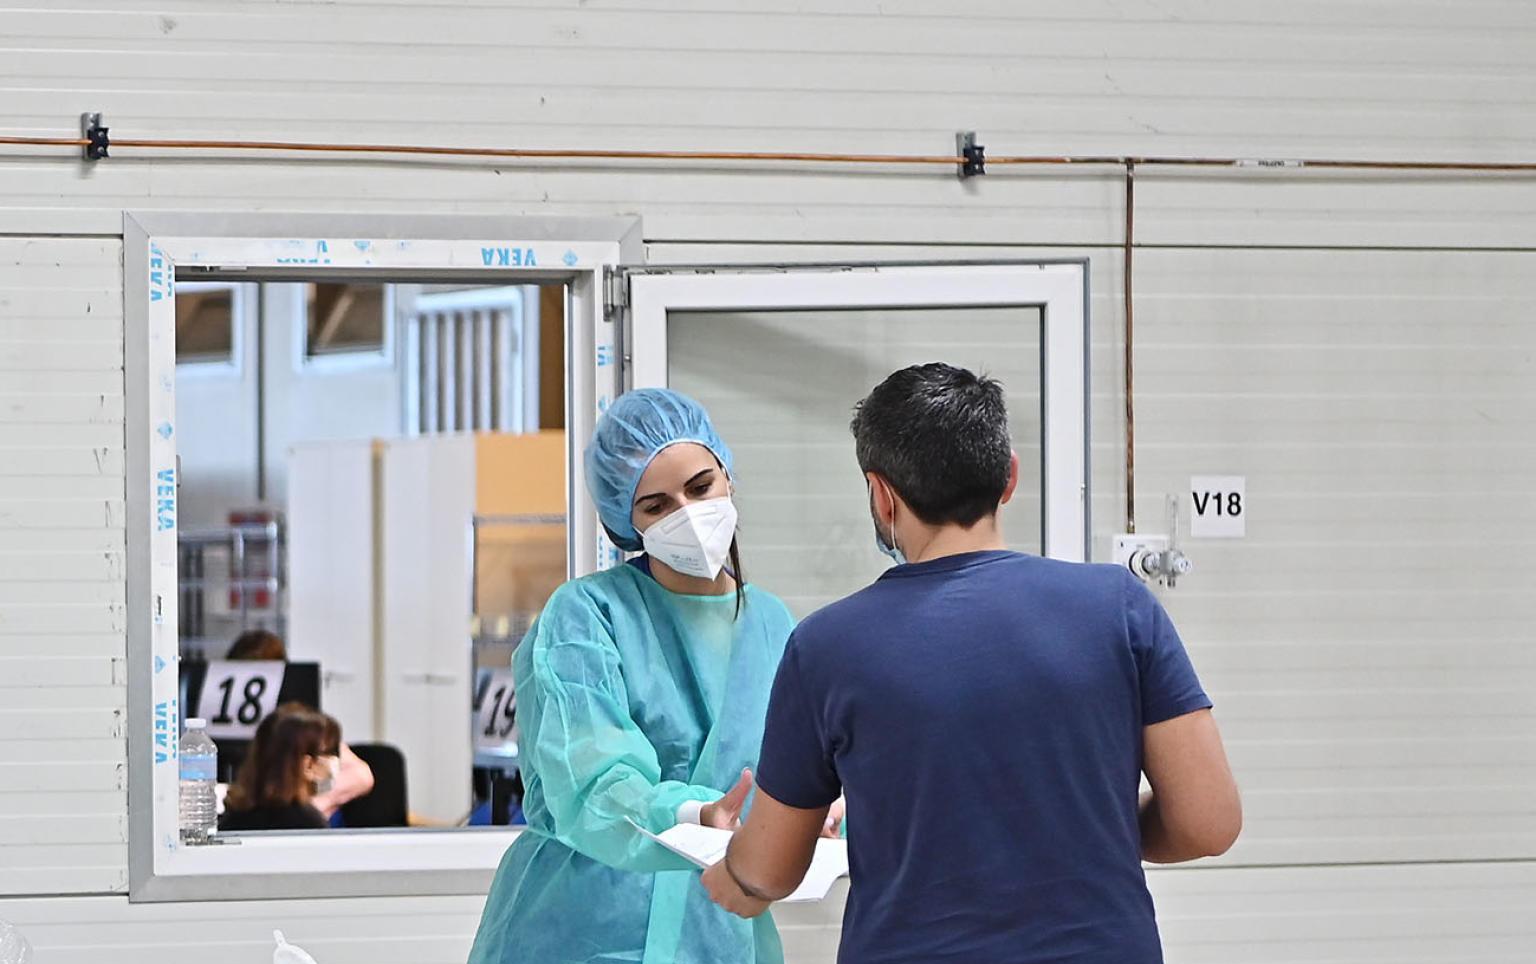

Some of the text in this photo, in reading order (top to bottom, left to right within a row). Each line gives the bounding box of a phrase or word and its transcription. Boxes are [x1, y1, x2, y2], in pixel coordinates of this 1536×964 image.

[481, 247, 536, 266] VEKA
[157, 469, 174, 531] VEKA
[1192, 491, 1242, 516] V18
[211, 675, 267, 725] 18
[154, 702, 167, 763] VEKA
